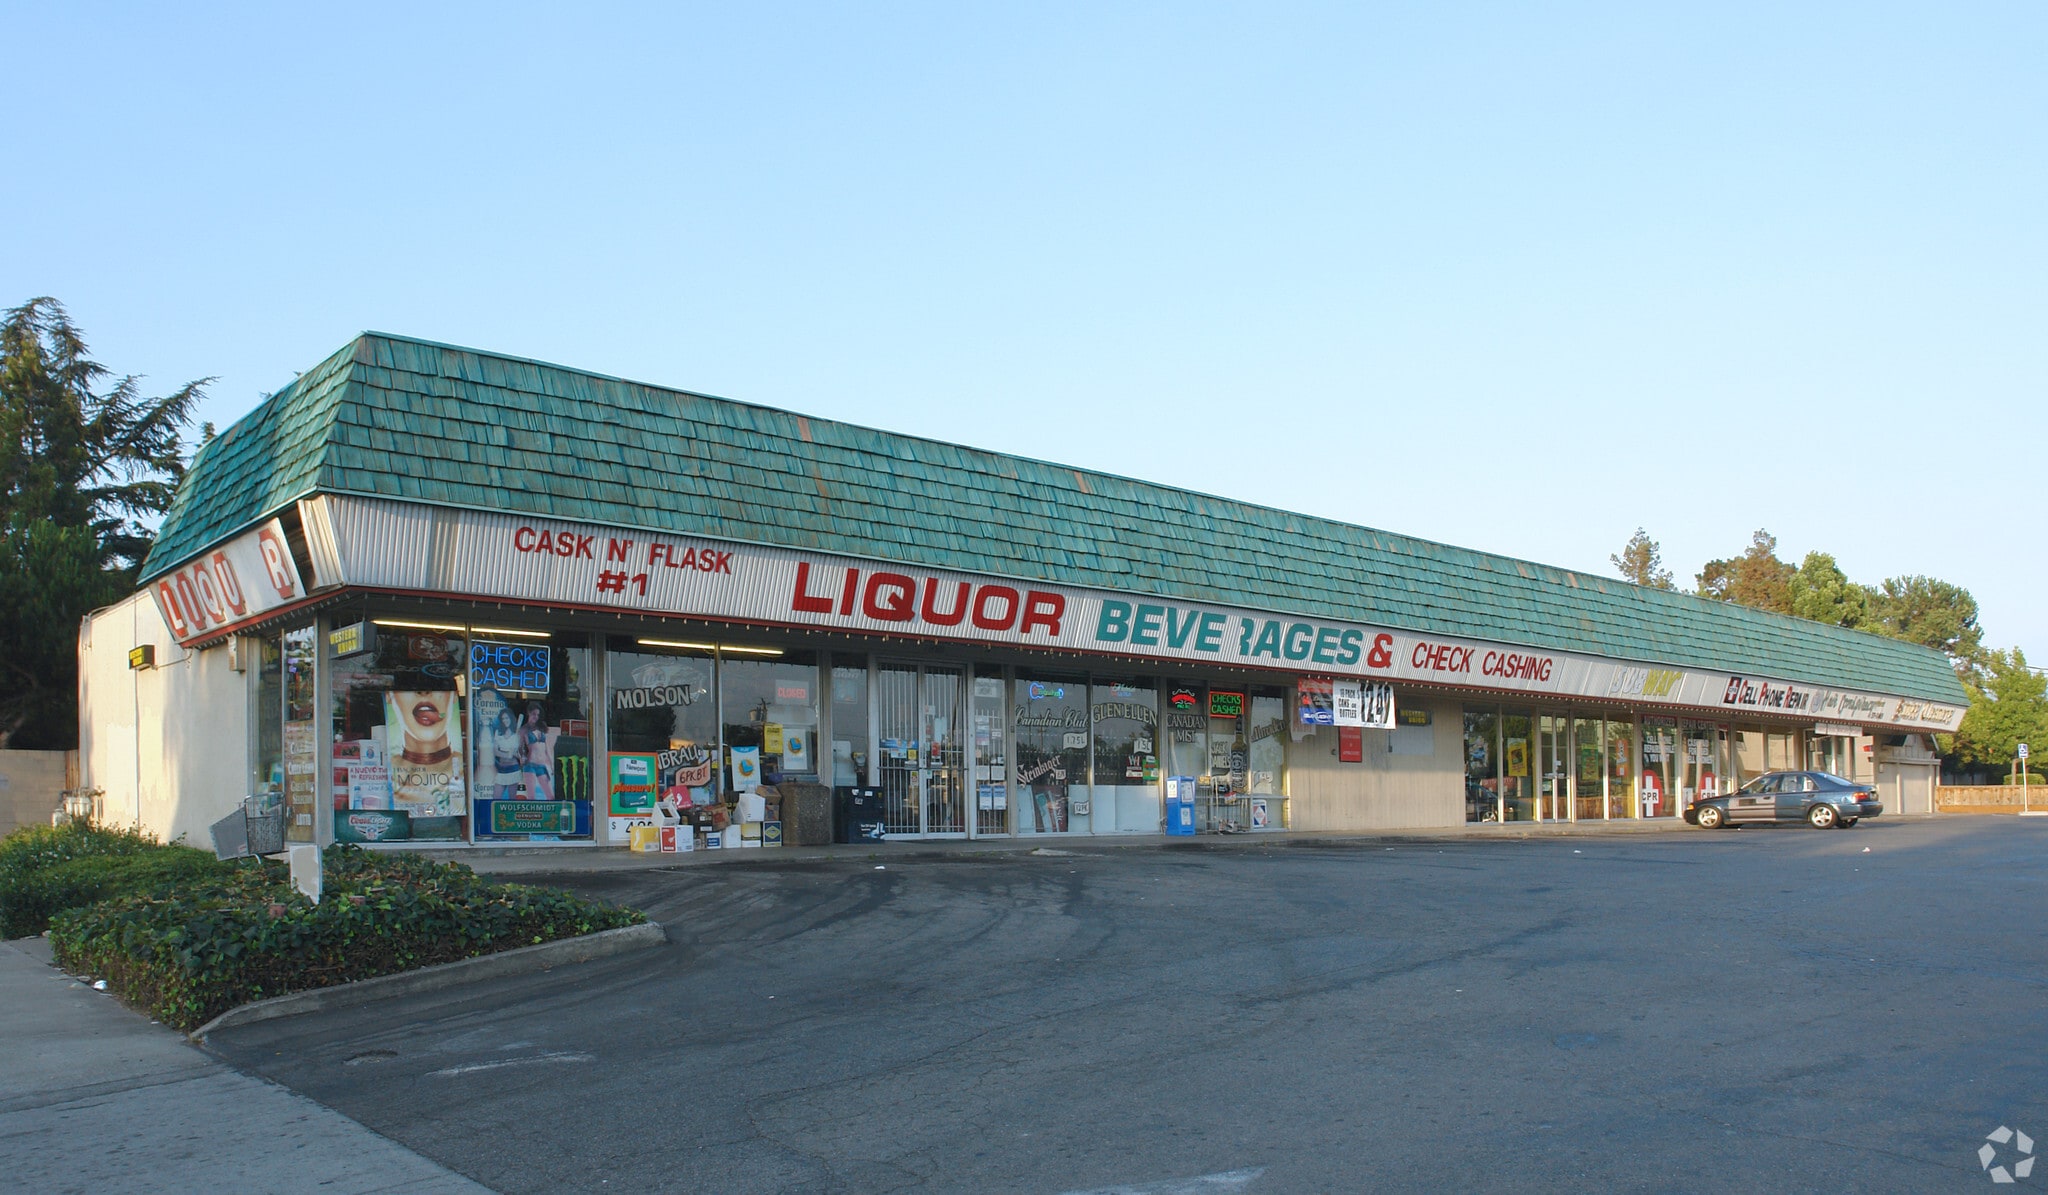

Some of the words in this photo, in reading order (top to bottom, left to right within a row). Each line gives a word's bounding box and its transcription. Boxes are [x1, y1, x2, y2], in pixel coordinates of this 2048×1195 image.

[515, 526, 594, 559] CASK
[609, 538, 636, 563] N'
[650, 542, 734, 575] FLASK
[598, 569, 649, 597] #1
[793, 562, 1067, 636] LIQUOR
[471, 644, 548, 669] CHECKS
[1367, 633, 1393, 668] &
[1412, 642, 1475, 673] CHECK
[1482, 650, 1553, 682] CASHING
[471, 667, 549, 689] CASHED
[1611, 665, 1683, 698] SUBWAY
[475, 699, 505, 709] Corona
[617, 685, 692, 709] MOLSON
[1211, 694, 1241, 704] CHECKS
[1738, 679, 1757, 705] CELL
[1758, 682, 1785, 707] PHONE
[1784, 686, 1810, 711] REPAIR
[1015, 704, 1062, 727] Canadian
[1092, 703, 1122, 723] GLEN
[1124, 704, 1158, 727] ELLEN
[1167, 713, 1207, 729] CANADIAN
[1211, 705, 1242, 715] CASHED
[1176, 729, 1195, 743] MIST
[397, 774, 450, 787] MOJITO
[612, 782, 656, 795] pleasure!
[500, 803, 556, 812] WOLFSCHMIDT
[1642, 792, 1658, 801] CPR
[517, 821, 542, 829] VODKA
